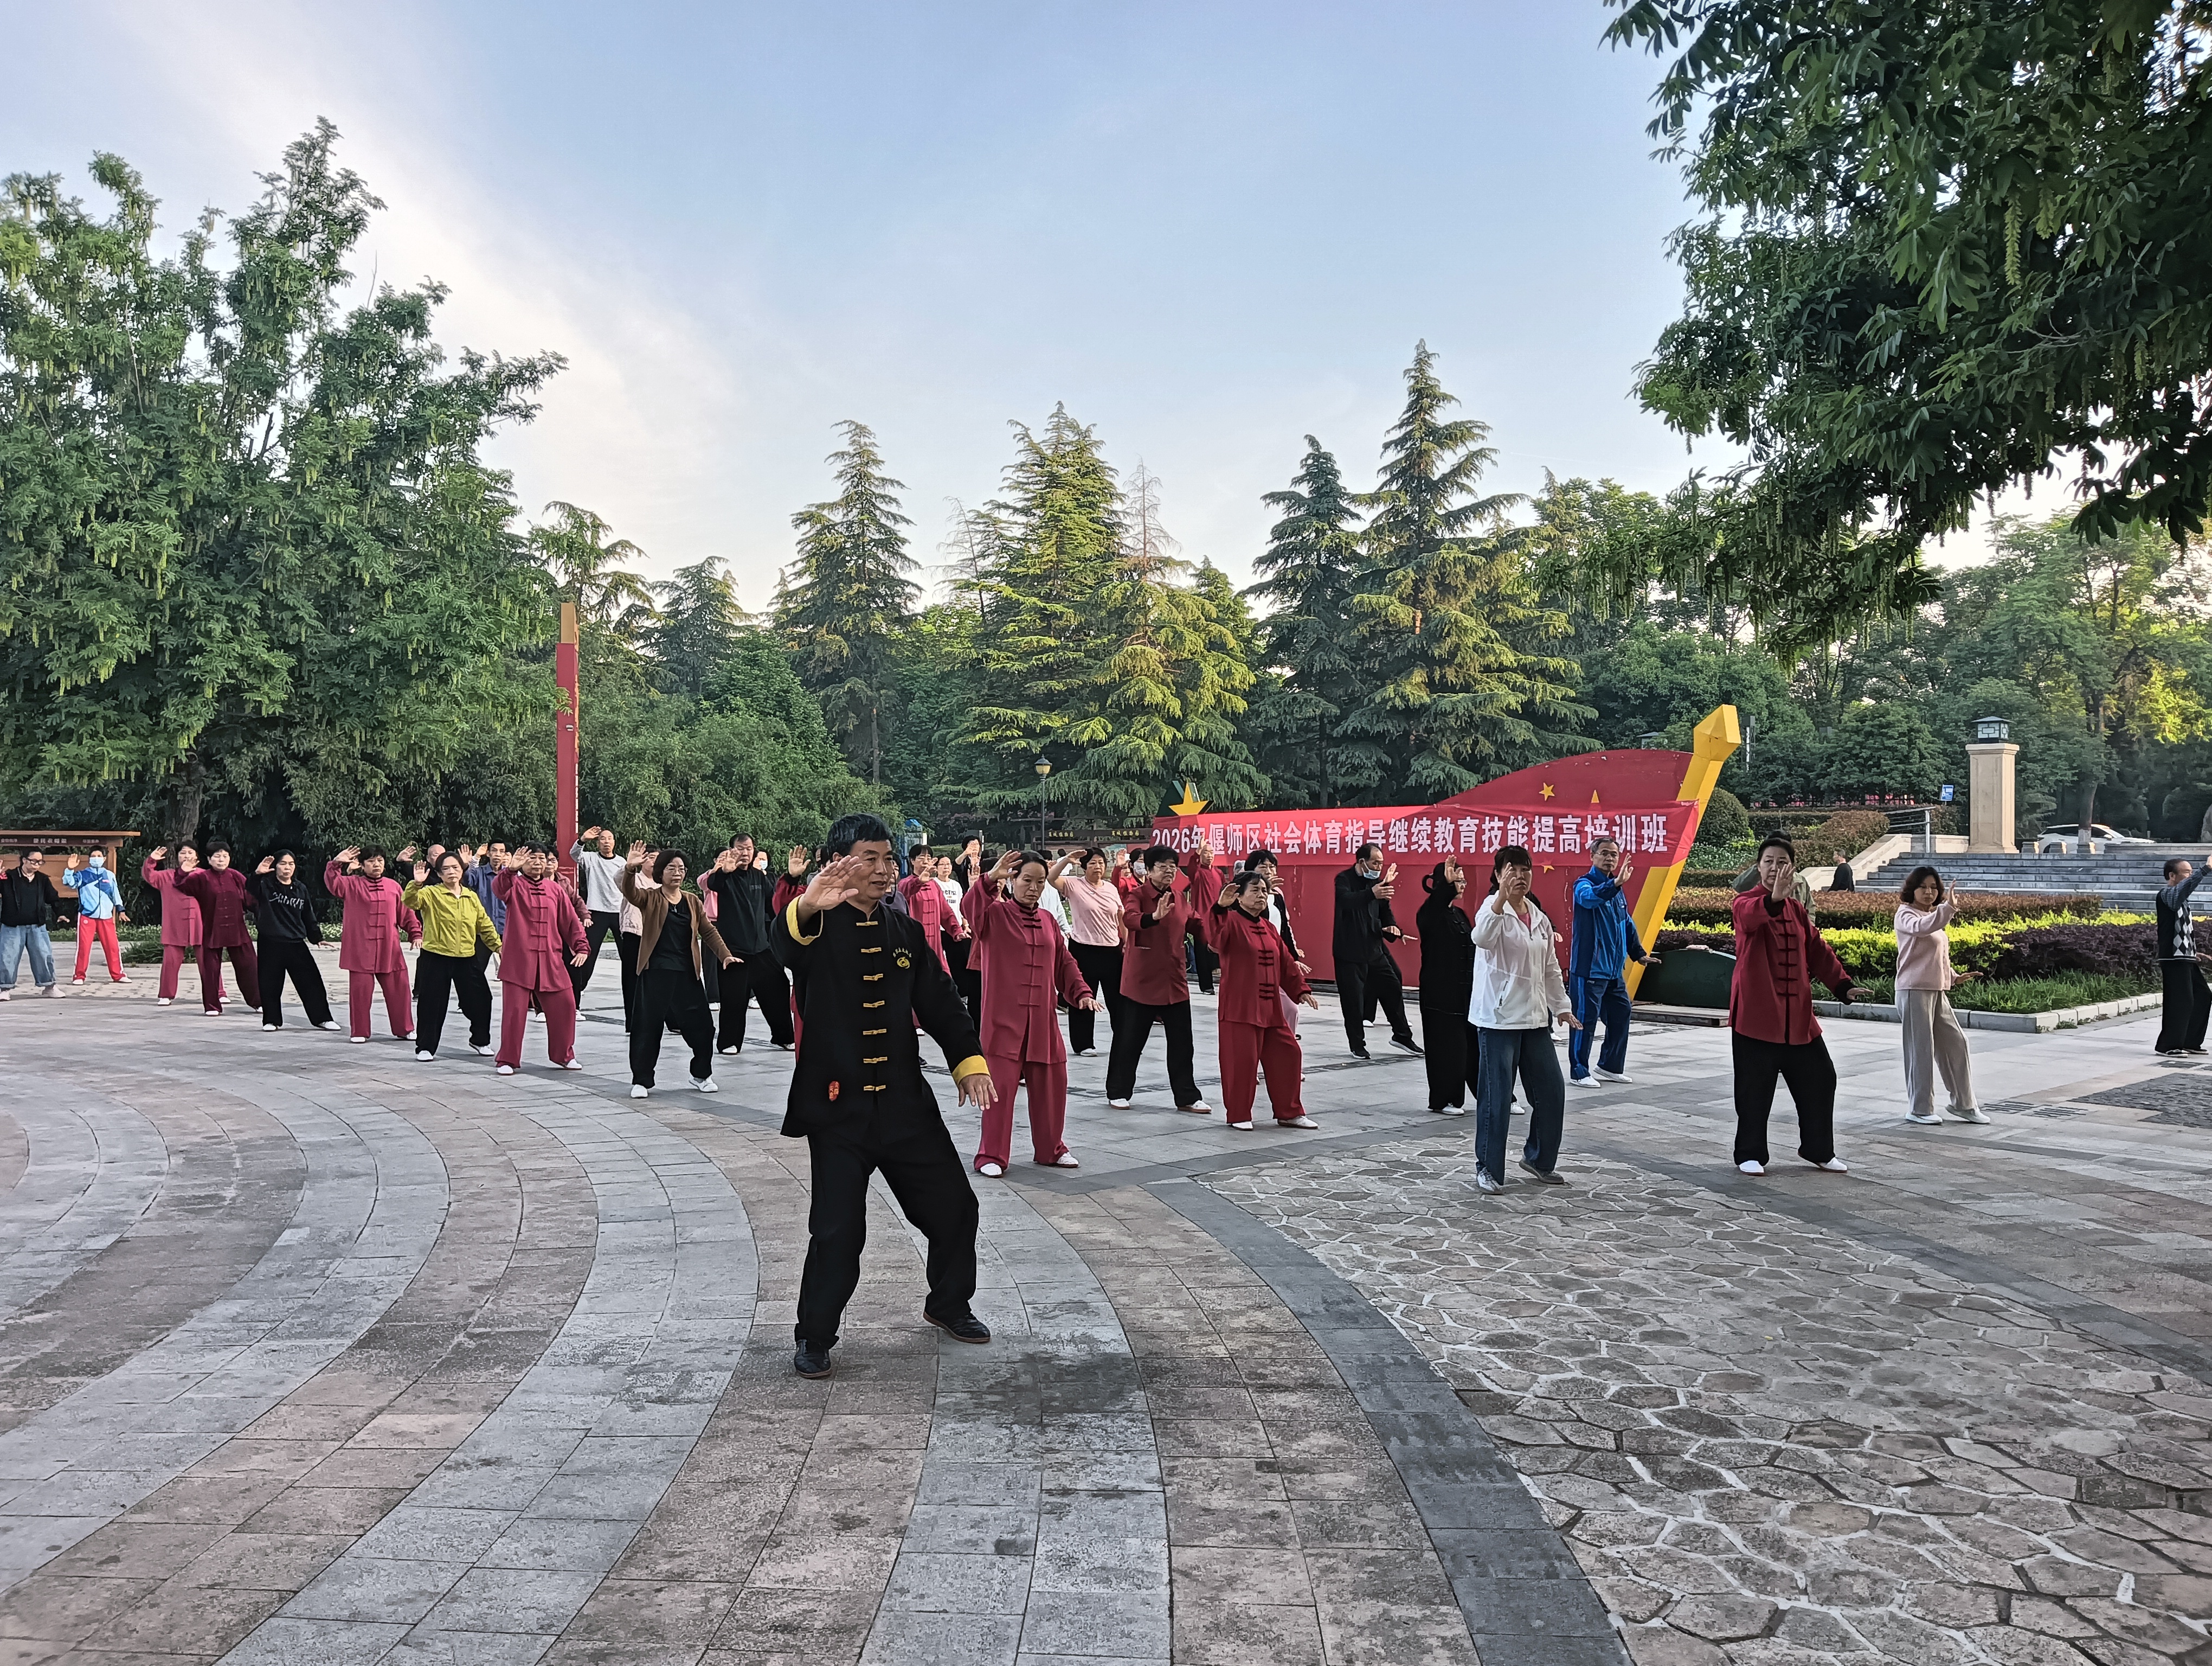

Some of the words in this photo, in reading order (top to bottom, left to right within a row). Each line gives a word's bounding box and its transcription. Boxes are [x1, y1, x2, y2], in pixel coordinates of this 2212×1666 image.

[1152, 813, 1668, 856] 2026年偃师区社会体育指导继续教育技能提高培训班
